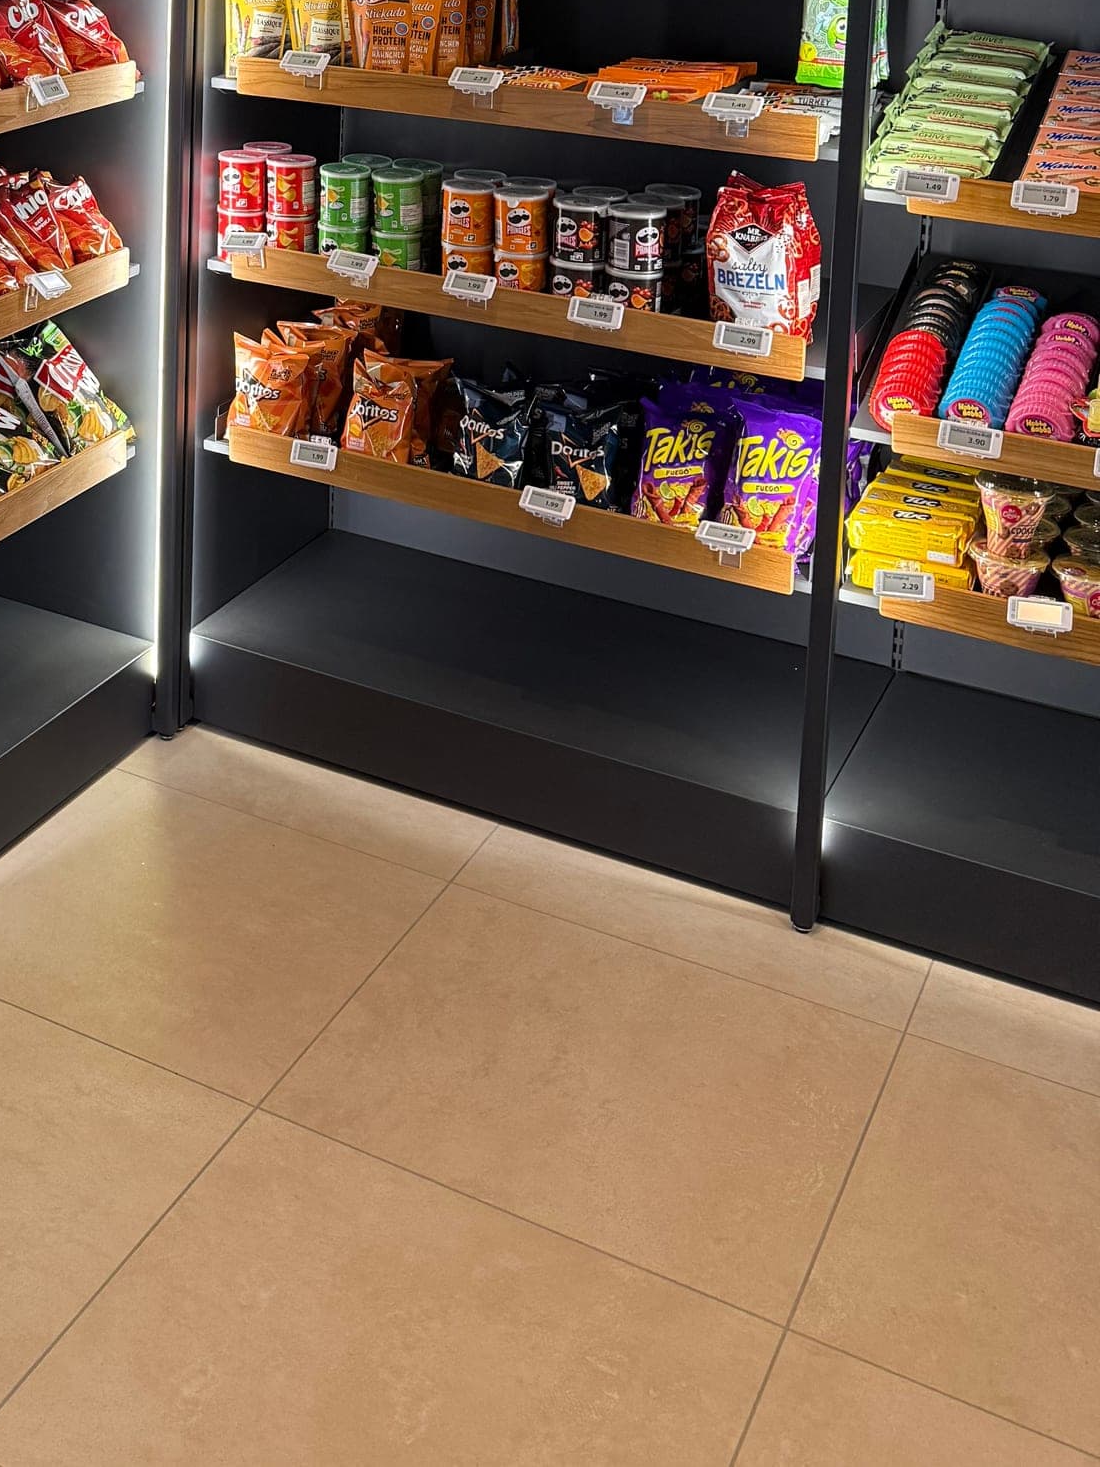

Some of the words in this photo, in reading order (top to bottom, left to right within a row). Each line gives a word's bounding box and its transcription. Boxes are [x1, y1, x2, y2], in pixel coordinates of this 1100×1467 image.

[67, 4, 105, 30] Chio
[364, 8, 406, 19] Stickado
[311, 25, 341, 35] CLASSIQUE
[372, 25, 393, 35] HIGH
[372, 36, 406, 47] PROTEIN
[973, 35, 1004, 44] CHIVES
[947, 92, 979, 101] CHIVES
[933, 109, 965, 119] CHIVES
[918, 132, 950, 141] CHIVES
[1047, 132, 1100, 143] Manne
[910, 152, 944, 161] CHIVES
[1036, 161, 1098, 171] Manner
[925, 183, 942, 191] 1.49
[1043, 195, 1060, 203] 1.79
[731, 257, 769, 273] salty
[717, 268, 785, 291] BREZELN
[740, 336, 756, 345] 2.99
[235, 379, 280, 400] Doritos
[351, 400, 398, 421] Doritos
[460, 414, 505, 441] Doritos
[967, 437, 986, 446] 3.90
[551, 440, 605, 458] Doritos
[645, 427, 716, 472] Takis
[738, 436, 813, 480] Takis
[665, 468, 687, 477] FUEGO
[755, 485, 779, 493] FUEGO
[914, 483, 948, 493] TUC
[545, 500, 559, 508] 1.99
[904, 496, 940, 507] TUC
[895, 511, 930, 520] TUC
